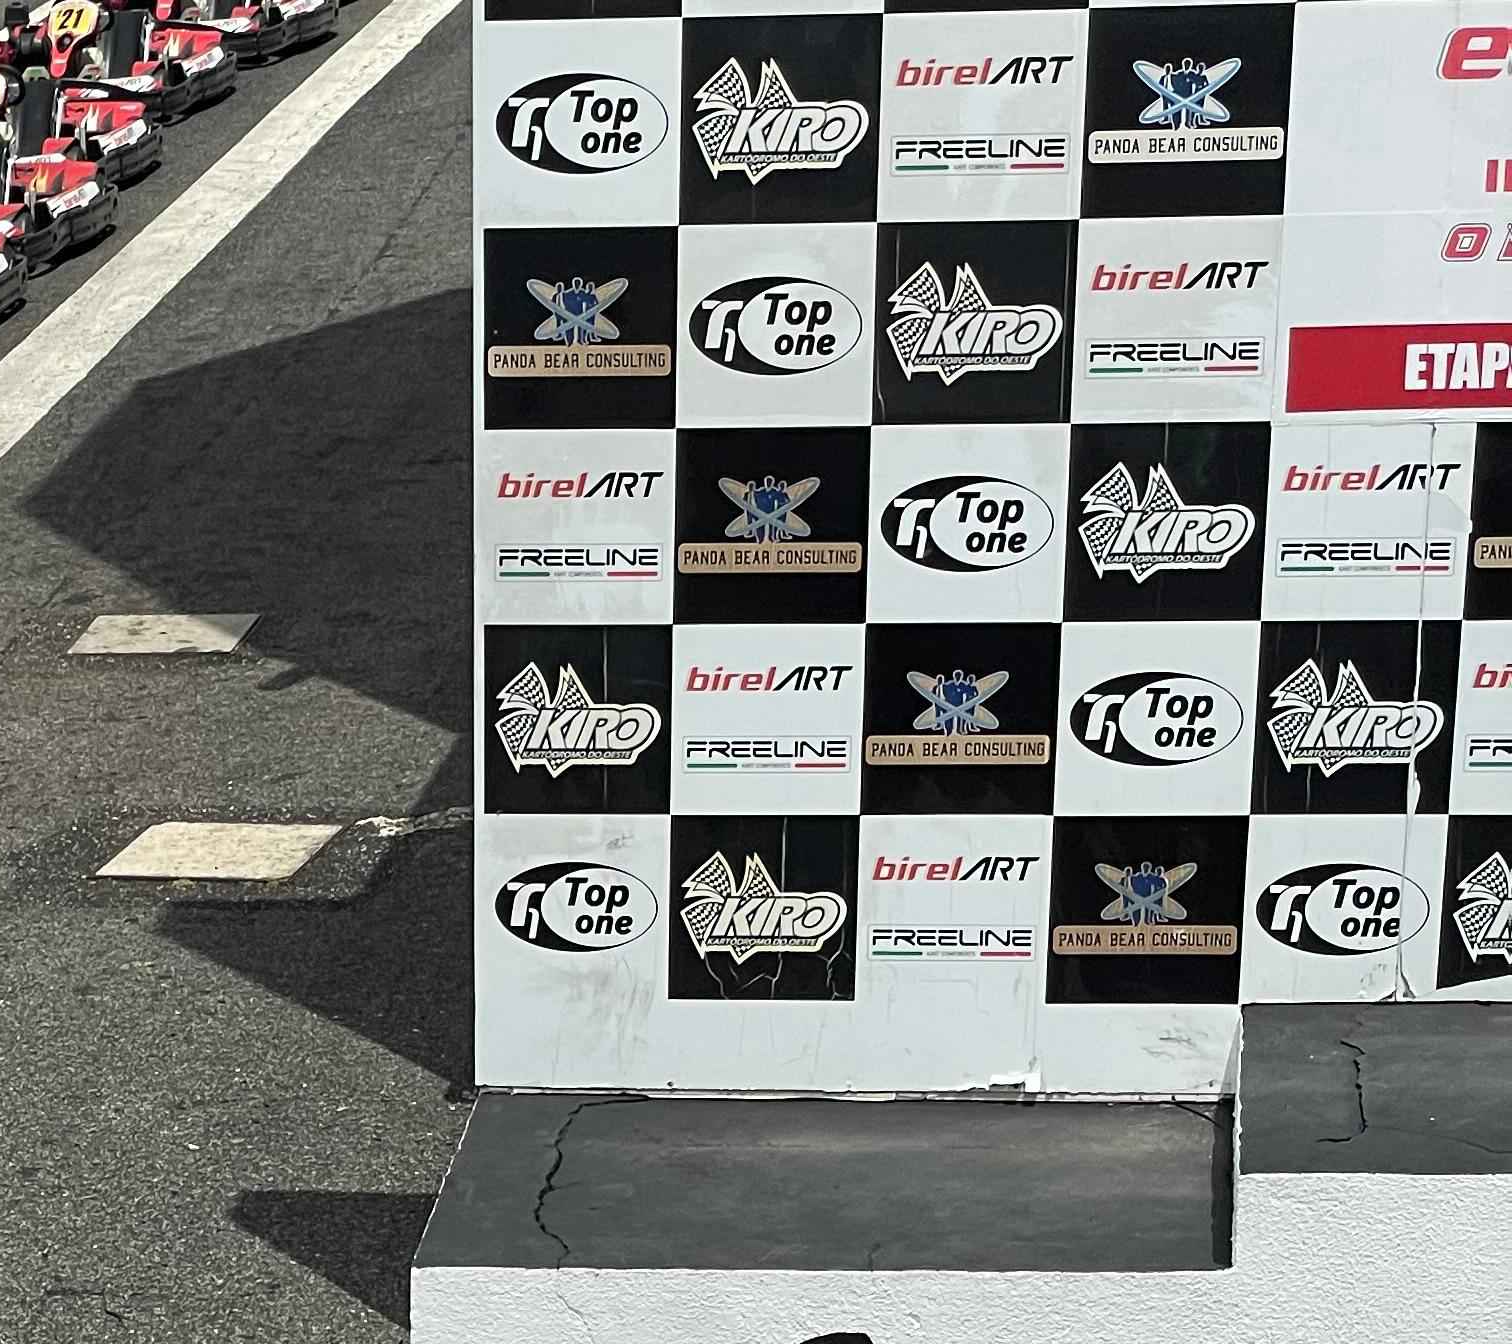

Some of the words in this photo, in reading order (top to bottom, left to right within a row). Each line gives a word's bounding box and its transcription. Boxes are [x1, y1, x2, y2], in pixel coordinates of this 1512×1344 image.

[895, 55, 1074, 86] birelART
[570, 89, 639, 130] Top
[723, 106, 862, 152] KIRO
[580, 131, 642, 154] one
[895, 138, 1066, 160] FREELINE
[1094, 138, 1140, 155] PANDA
[1148, 137, 1186, 153] BEAR
[1193, 135, 1278, 152] CONSULTING
[1091, 261, 1270, 291] birelART
[763, 293, 833, 333] Top
[917, 309, 1056, 355] KIRO
[774, 334, 836, 356] one
[1089, 341, 1260, 362] FREELINE
[493, 353, 536, 369] PANDA
[543, 353, 579, 369] BEAR
[586, 352, 666, 368] CONSULTING
[1404, 342, 1512, 391] ETAP
[496, 471, 665, 498] birelART
[955, 491, 1025, 531] Top
[965, 531, 1028, 553] one
[1109, 509, 1248, 554] KIRO
[498, 548, 659, 567] FREELINE
[683, 550, 727, 565] PANDA
[734, 550, 770, 565] BEAR
[776, 549, 857, 565] CONSULTING
[1280, 542, 1452, 561] FREELINE
[1479, 544, 1512, 560] PAN
[686, 665, 854, 692] birelART
[1145, 687, 1214, 725] Top
[525, 707, 655, 751] KIRO
[1154, 726, 1217, 748] one
[1297, 705, 1437, 749] KIRO
[687, 740, 847, 758] FREELINE
[871, 742, 915, 757] PANDA
[922, 742, 958, 757] BEAR
[964, 742, 1045, 757] CONSULTING
[871, 856, 1041, 881] birelART
[564, 877, 630, 914] Top
[1332, 878, 1401, 916] Top
[575, 914, 634, 936] one
[710, 896, 839, 938] KIRO
[1340, 916, 1401, 938] one
[872, 929, 1033, 947] FREELINE
[1058, 933, 1102, 947] PANDA
[1110, 933, 1145, 947] BEAR
[1151, 932, 1232, 947] CONSULTING
